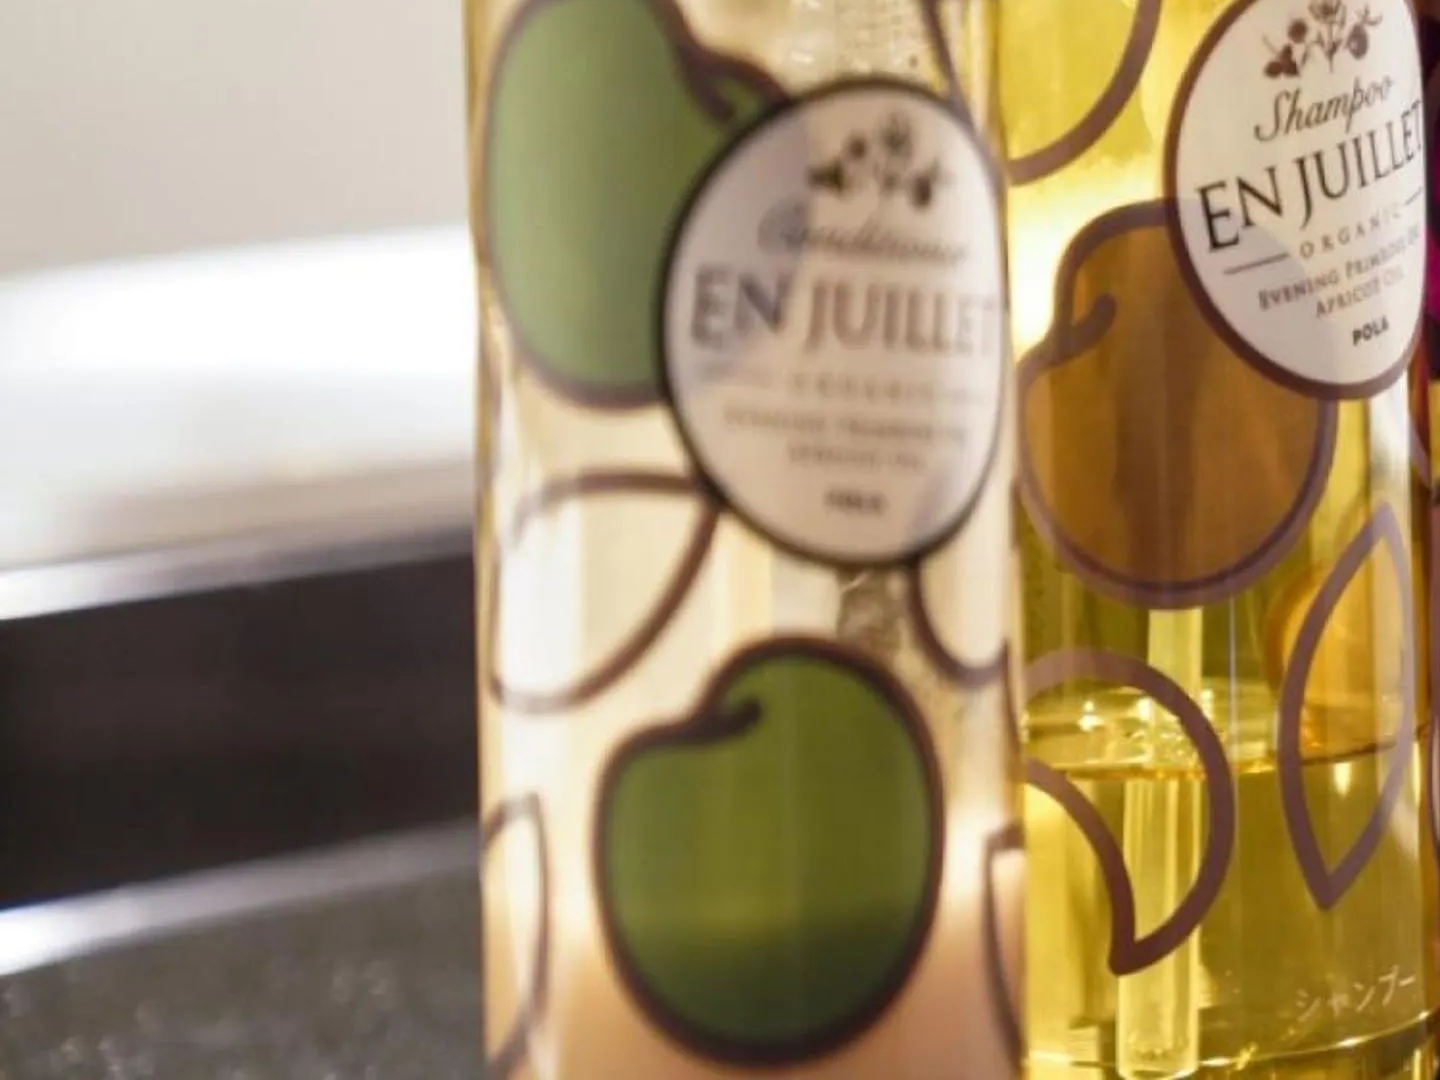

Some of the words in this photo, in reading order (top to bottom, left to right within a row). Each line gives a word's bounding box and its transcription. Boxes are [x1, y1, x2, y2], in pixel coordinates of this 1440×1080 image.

[1253, 75, 1395, 143] Shampoo
[1195, 165, 1284, 253] EN
[1294, 98, 1421, 231] JUILLET
[690, 261, 796, 352] EN
[1258, 269, 1340, 311] EVENING
[1352, 314, 1389, 346] POLA
[1296, 964, 1417, 1023] シャンプー
